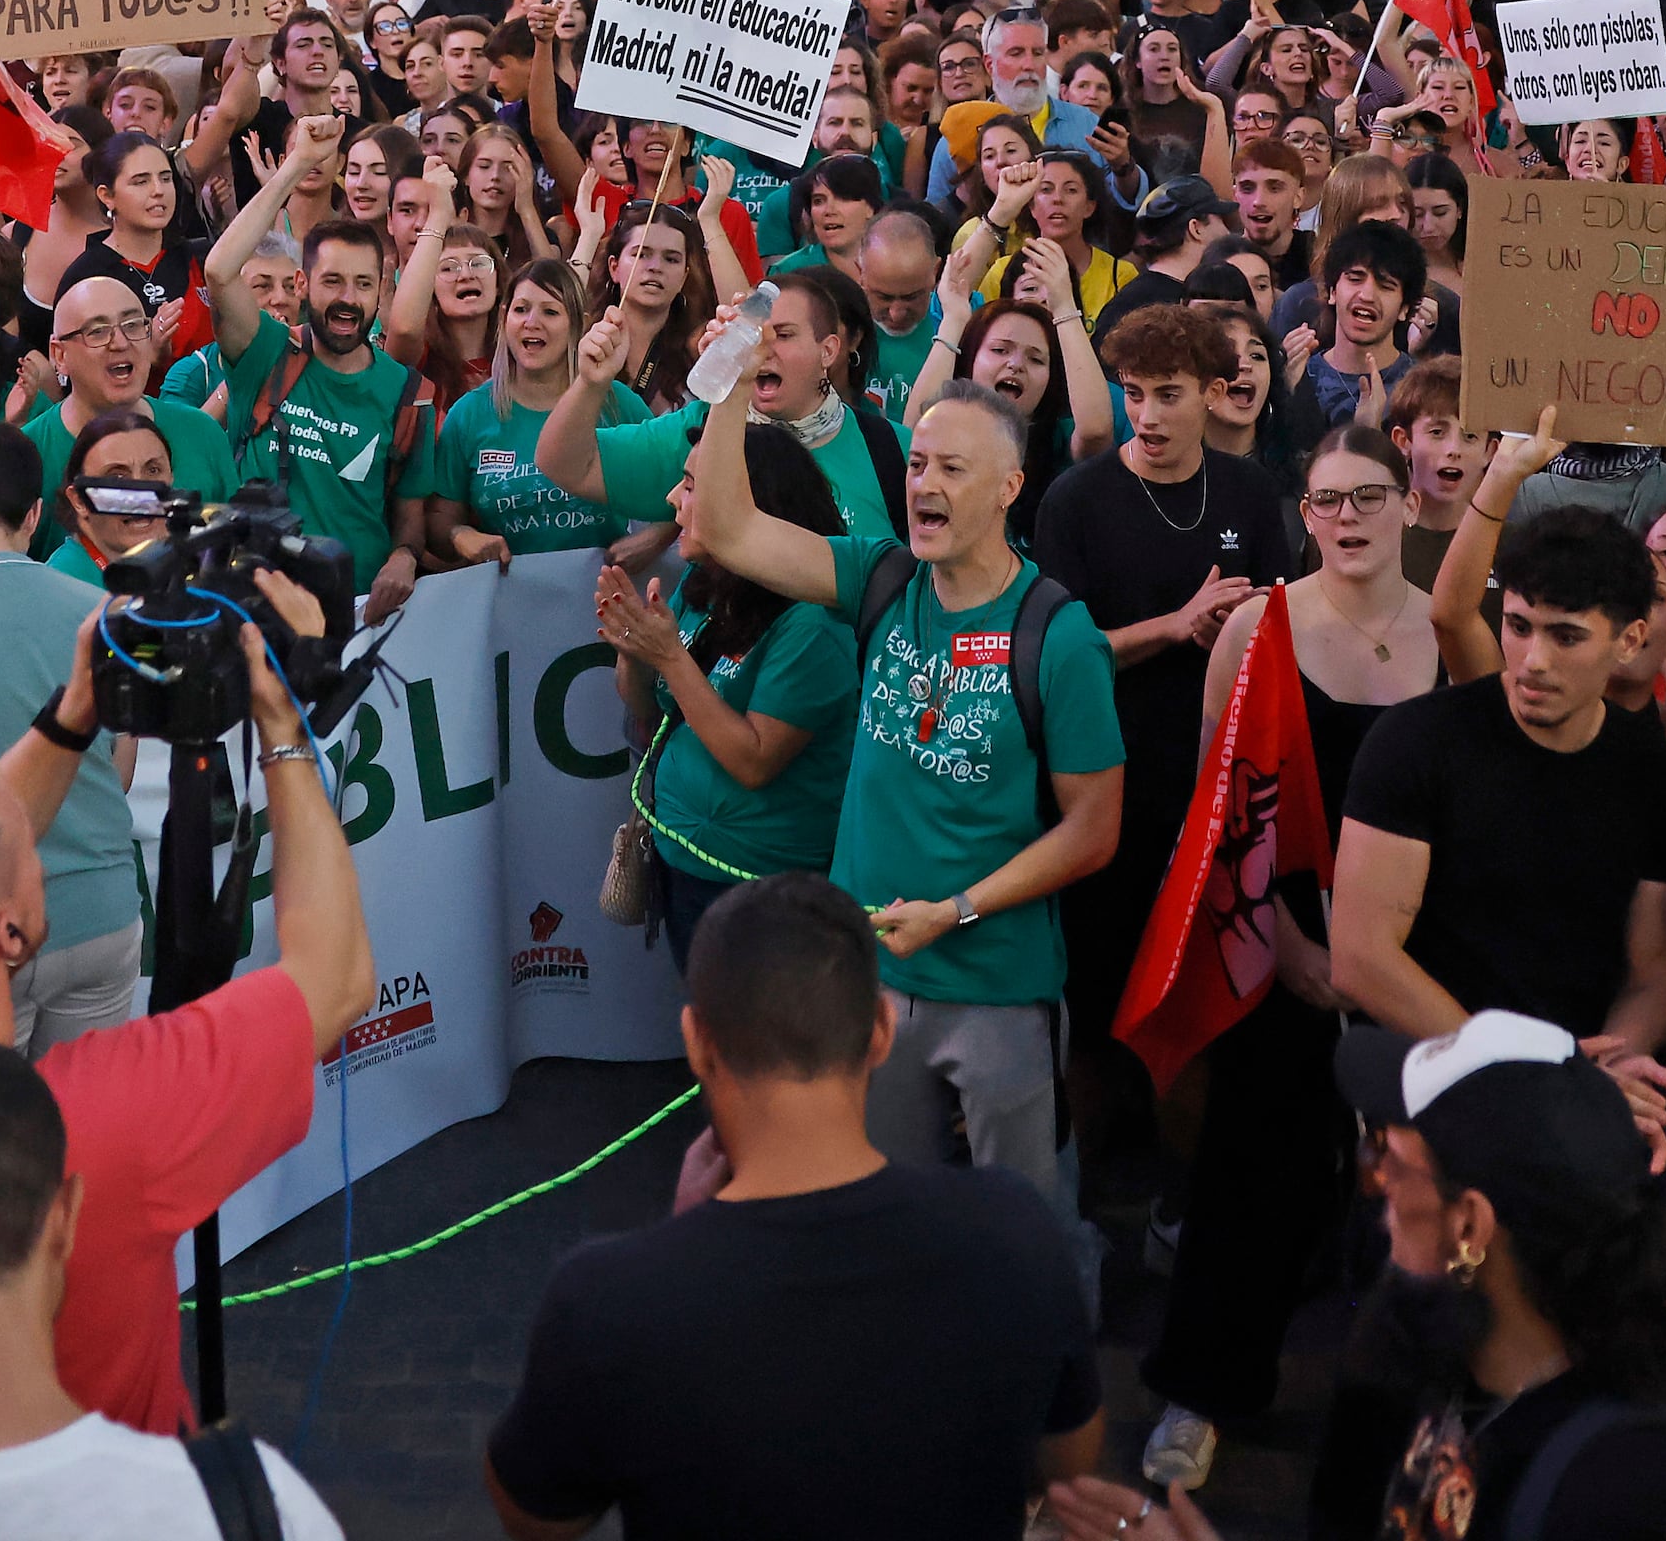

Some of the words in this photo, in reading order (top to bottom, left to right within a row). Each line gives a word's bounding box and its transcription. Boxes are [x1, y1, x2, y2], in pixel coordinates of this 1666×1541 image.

[1503, 20, 1543, 57] Unos,
[1543, 16, 1570, 50] sólo
[1573, 19, 1598, 48] con
[1600, 11, 1659, 55] pistolas;
[590, 19, 676, 85] Madrid,
[682, 43, 713, 81] ni
[709, 46, 731, 90] la
[734, 65, 820, 120] media!
[1514, 73, 1551, 105] otros,
[1553, 70, 1577, 98] con
[1580, 64, 1617, 103] leyes
[1620, 61, 1666, 92] roban.
[1500, 193, 1541, 225] LA
[1500, 244, 1532, 268] ES
[1547, 249, 1582, 271] UN
[1591, 290, 1661, 339] NO
[638, 361, 654, 390] Nikon
[1490, 357, 1528, 388] UN
[340, 422, 359, 438] FP
[480, 453, 515, 463] CCOO
[496, 497, 523, 513] DE
[1221, 543, 1240, 551] adidas
[956, 635, 1012, 652] CCOO
[872, 681, 901, 708] DE
[907, 741, 991, 784] TOD@S
[392, 1046, 404, 1058] DE
[405, 1035, 438, 1052] MADRID
